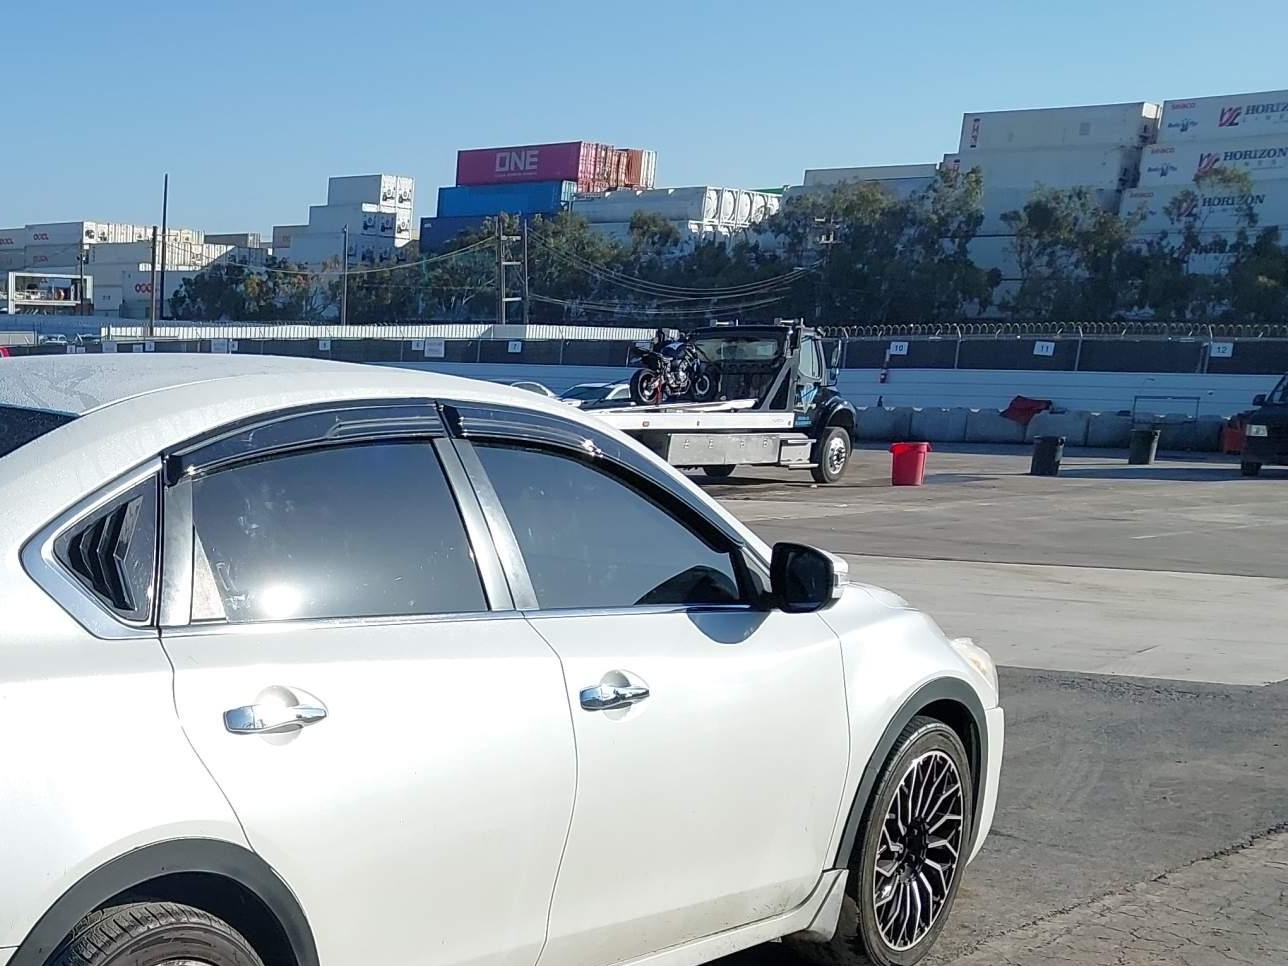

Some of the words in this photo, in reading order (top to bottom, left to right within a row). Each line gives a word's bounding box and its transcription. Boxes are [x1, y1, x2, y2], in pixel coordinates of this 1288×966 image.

[1223, 147, 1288, 160] HORIZON
[495, 150, 538, 172] ONE
[895, 344, 904, 352] 10
[1041, 344, 1049, 353] 11
[1217, 346, 1228, 354] 12
